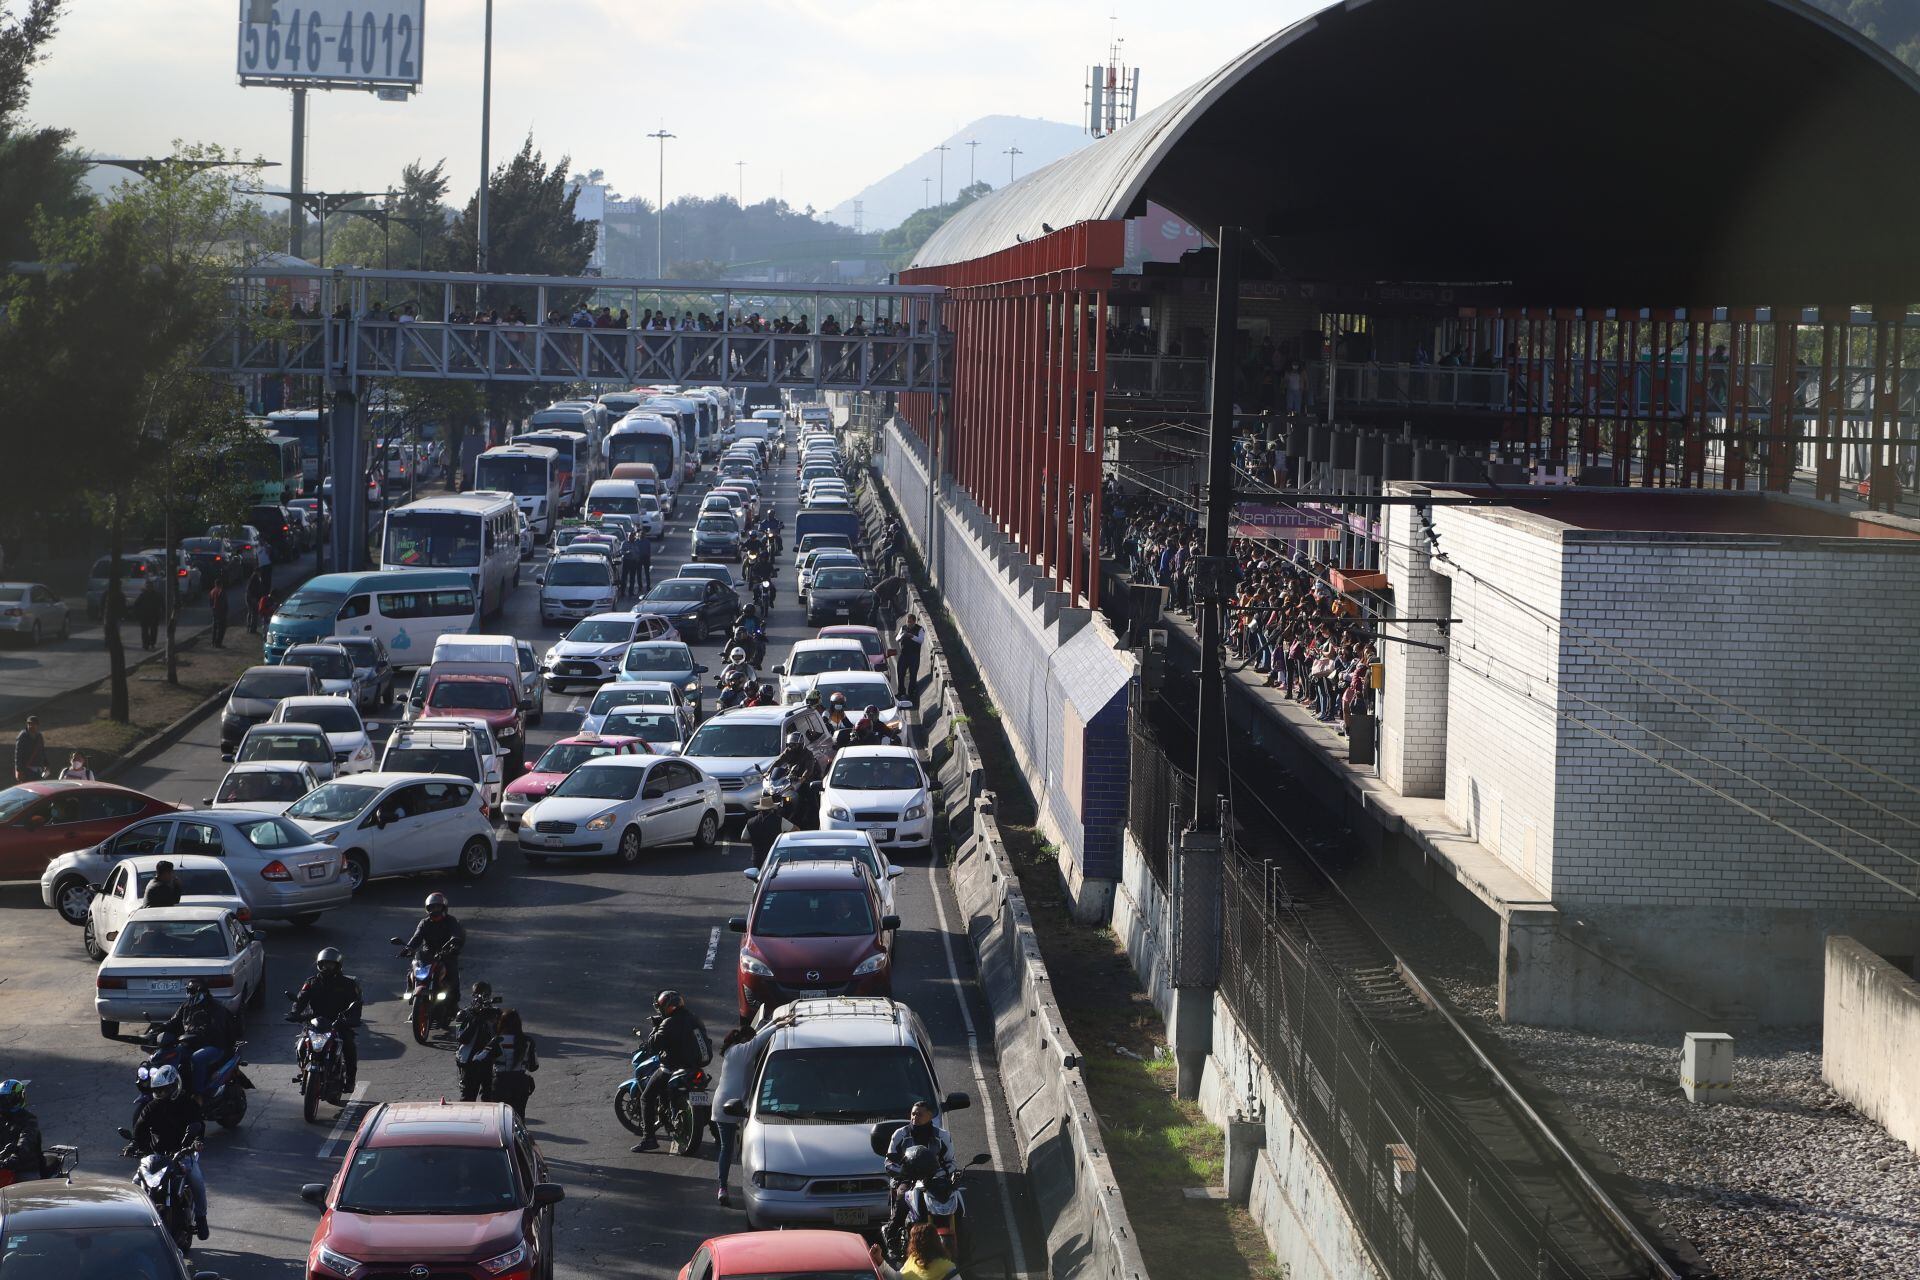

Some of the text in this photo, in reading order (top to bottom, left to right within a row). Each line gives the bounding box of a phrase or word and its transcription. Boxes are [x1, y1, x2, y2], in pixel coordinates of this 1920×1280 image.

[244, 8, 414, 77] 5646-4012
[606, 202, 637, 214] HOTEL
[1244, 513, 1328, 527] PANTITLAN
